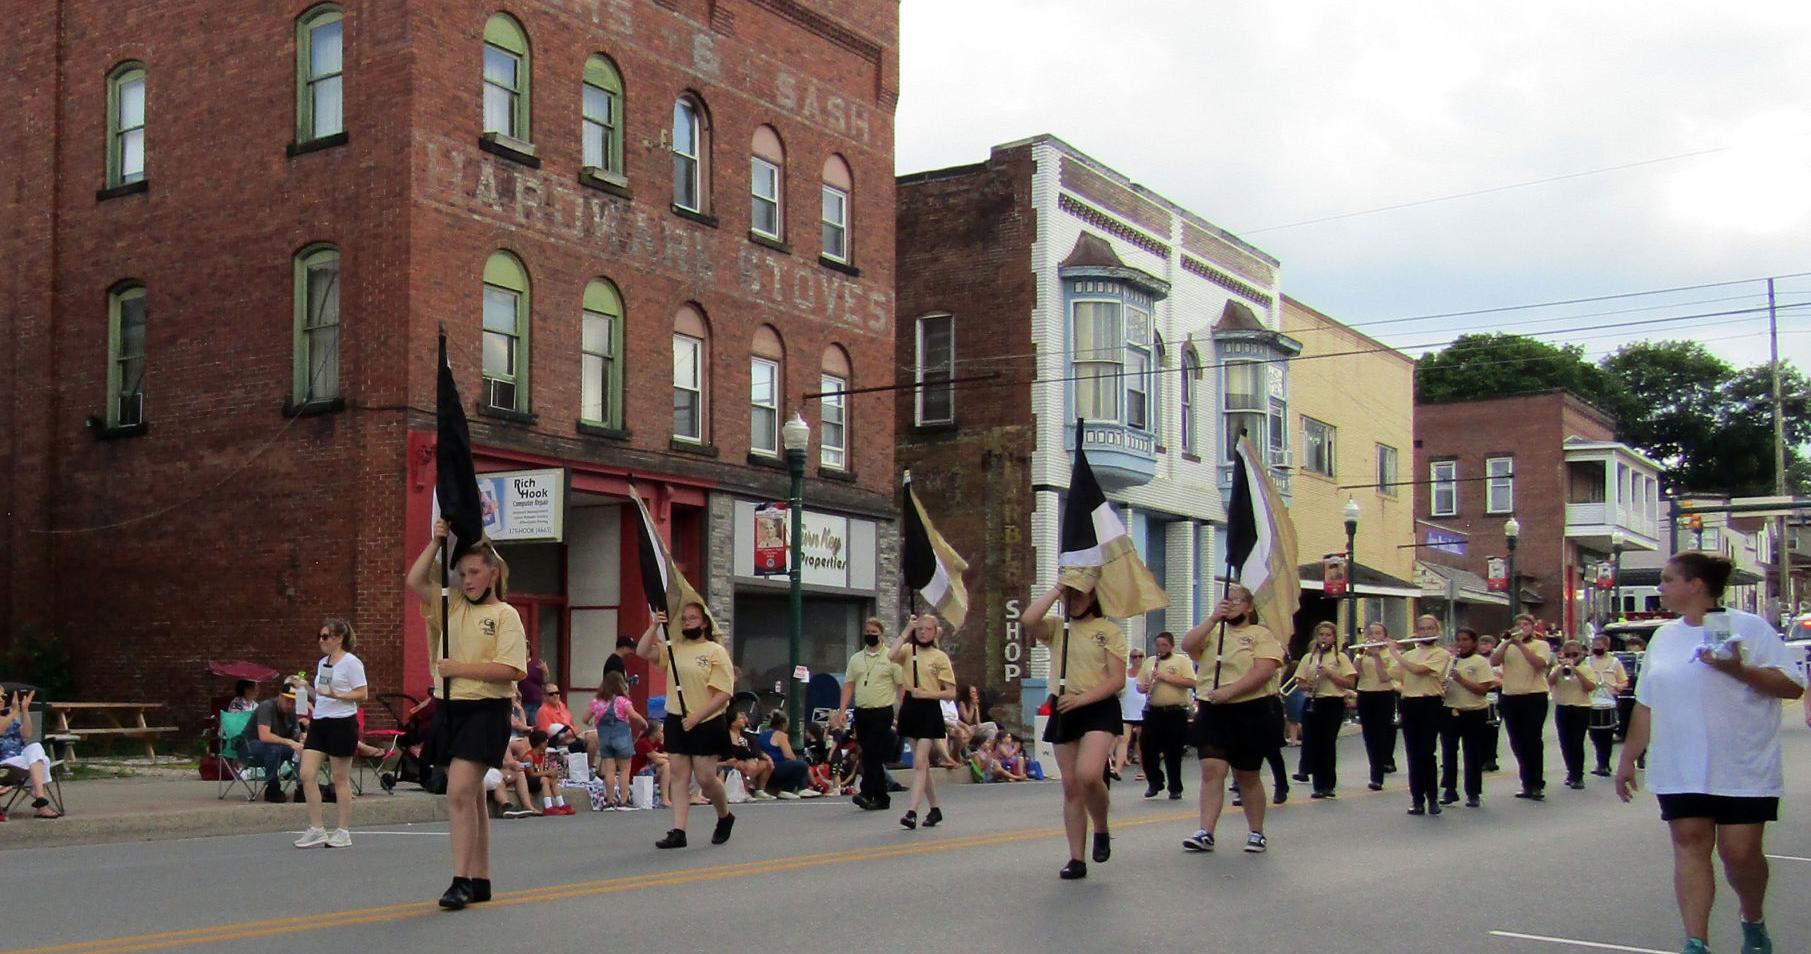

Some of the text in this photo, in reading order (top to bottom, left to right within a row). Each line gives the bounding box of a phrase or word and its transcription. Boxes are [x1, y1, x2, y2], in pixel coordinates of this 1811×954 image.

[776, 72, 871, 144] SASH
[738, 245, 889, 332] STOVES
[514, 478, 536, 489] Rich
[520, 489, 548, 499] Hook
[1004, 599, 1022, 683] SHOP
